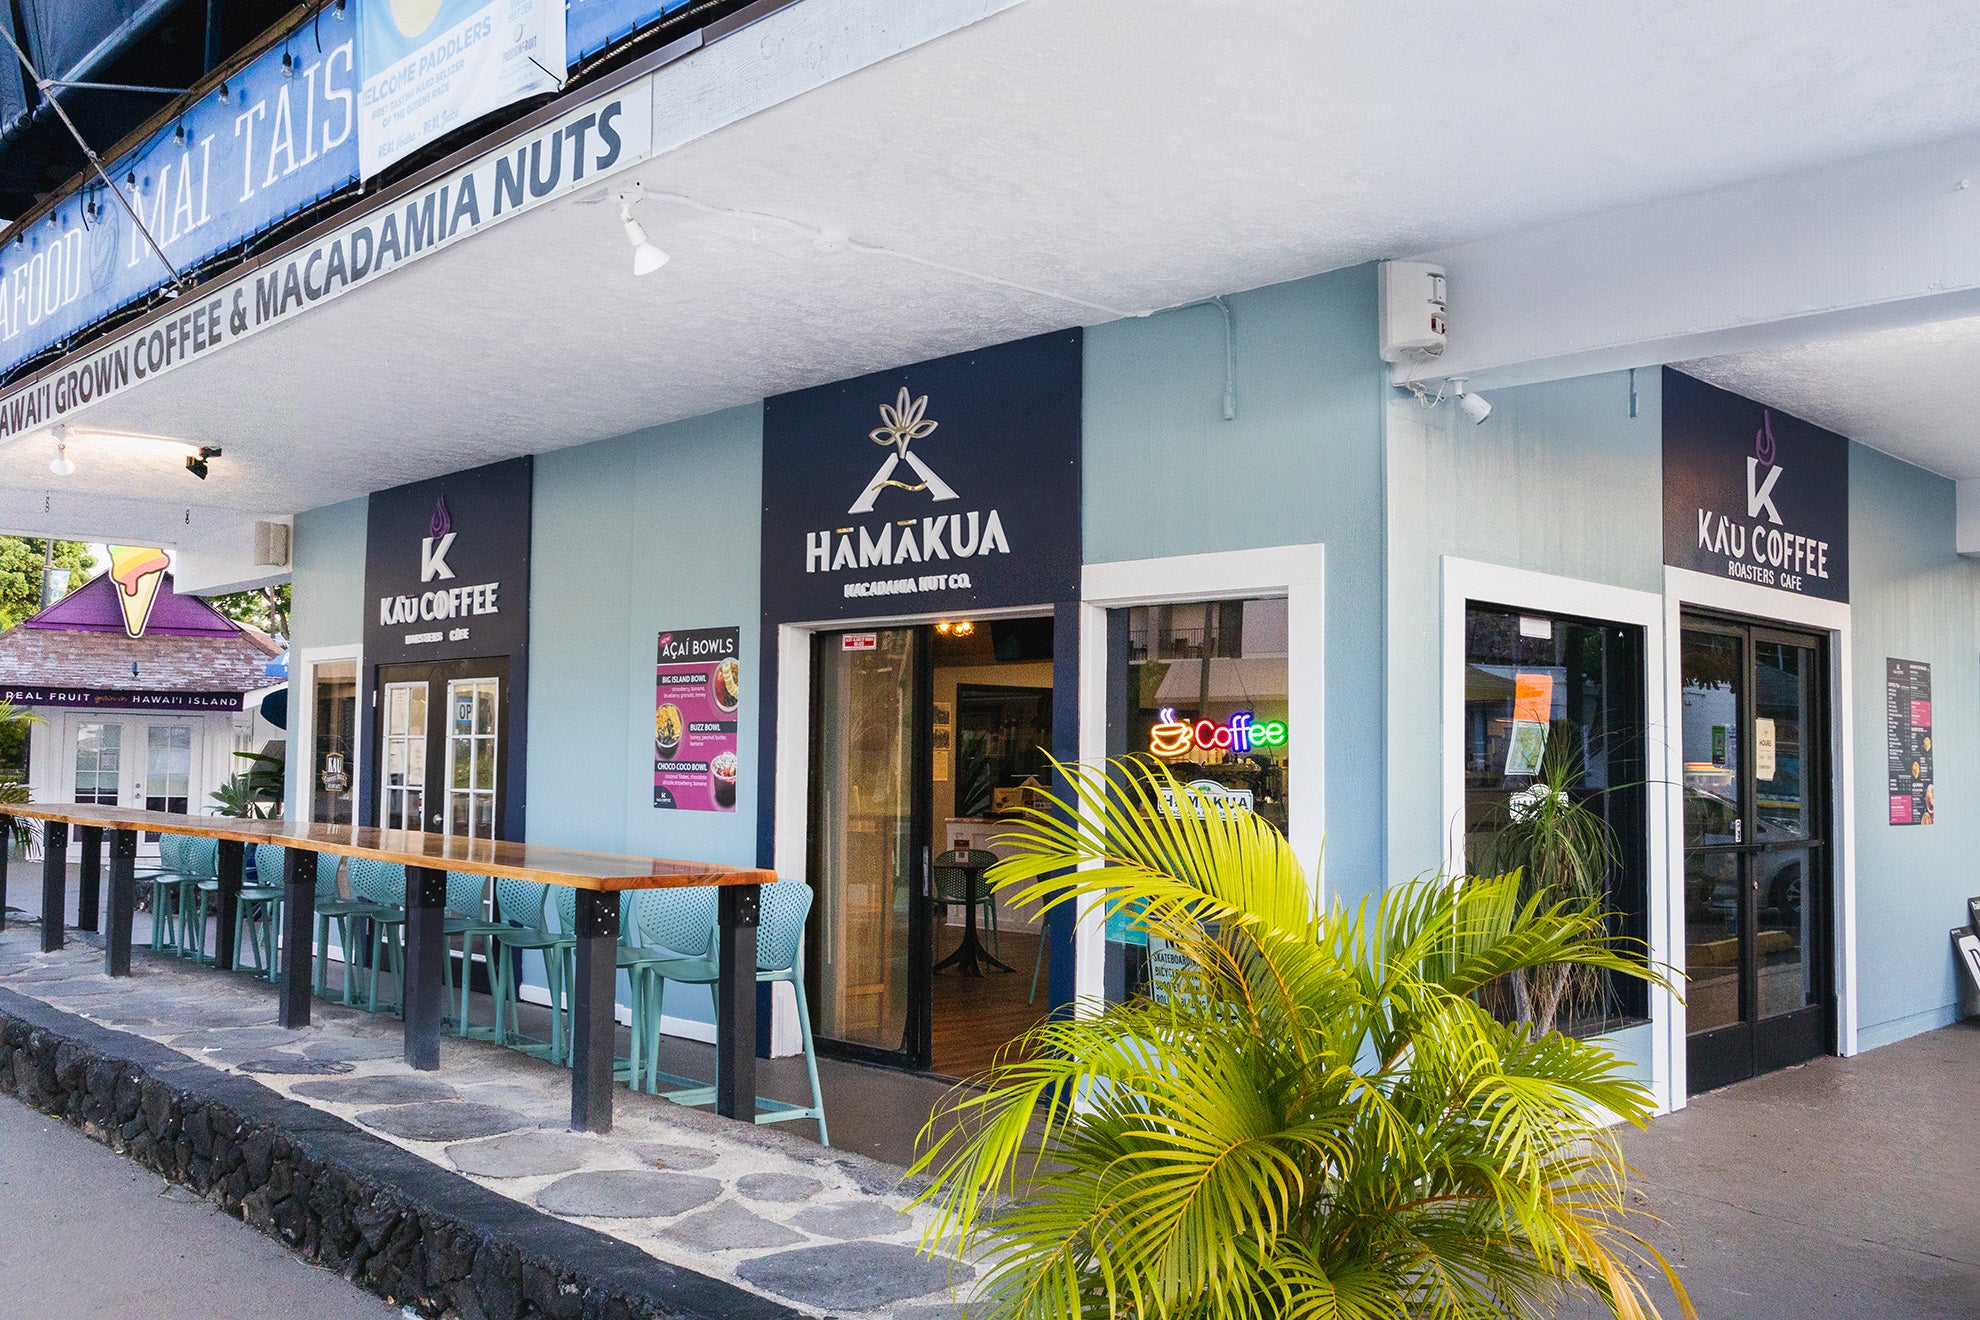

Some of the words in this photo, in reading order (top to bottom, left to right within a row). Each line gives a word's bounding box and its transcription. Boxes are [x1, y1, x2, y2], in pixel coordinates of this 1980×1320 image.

[361, 62, 416, 108] ELCOME
[418, 15, 492, 76] PADDLERS
[371, 104, 389, 120] BEST
[416, 76, 434, 94] HARD
[393, 108, 407, 121] THE
[432, 81, 450, 98] RACE
[127, 133, 216, 270] MAI
[234, 37, 355, 202] TAIS
[378, 139, 394, 158] REAL
[423, 115, 440, 135] REAL
[55, 345, 129, 415] GROWN
[133, 298, 223, 380] COFFEE
[229, 287, 249, 336] &
[256, 173, 480, 326] MACADAMIA
[493, 101, 622, 216] NUTS
[1747, 456, 1784, 526] K
[420, 532, 457, 582] K
[1751, 524, 1829, 580] COFFEE
[843, 578, 918, 598] MACADAMIA
[918, 574, 948, 592] NUT
[1728, 560, 1775, 585] ROASTERS
[1780, 572, 1802, 591] CAFE
[420, 582, 500, 621] COFFEE
[692, 638, 734, 655] BOWLS
[662, 675, 671, 684] BIG
[671, 674, 691, 684] ISLAND
[691, 674, 707, 683] BOWL
[6, 691, 44, 700] REAL
[50, 692, 91, 702] FRUIT
[188, 696, 238, 707] ISLAND
[459, 703, 473, 720] OP
[689, 723, 704, 731] BUZZ
[704, 723, 721, 731] BOWL
[1194, 711, 1287, 753] Coffee
[657, 762, 675, 771] CHOCO
[676, 763, 691, 771] COCO
[691, 763, 708, 771] BOWL
[1163, 794, 1249, 810] HMKUA
